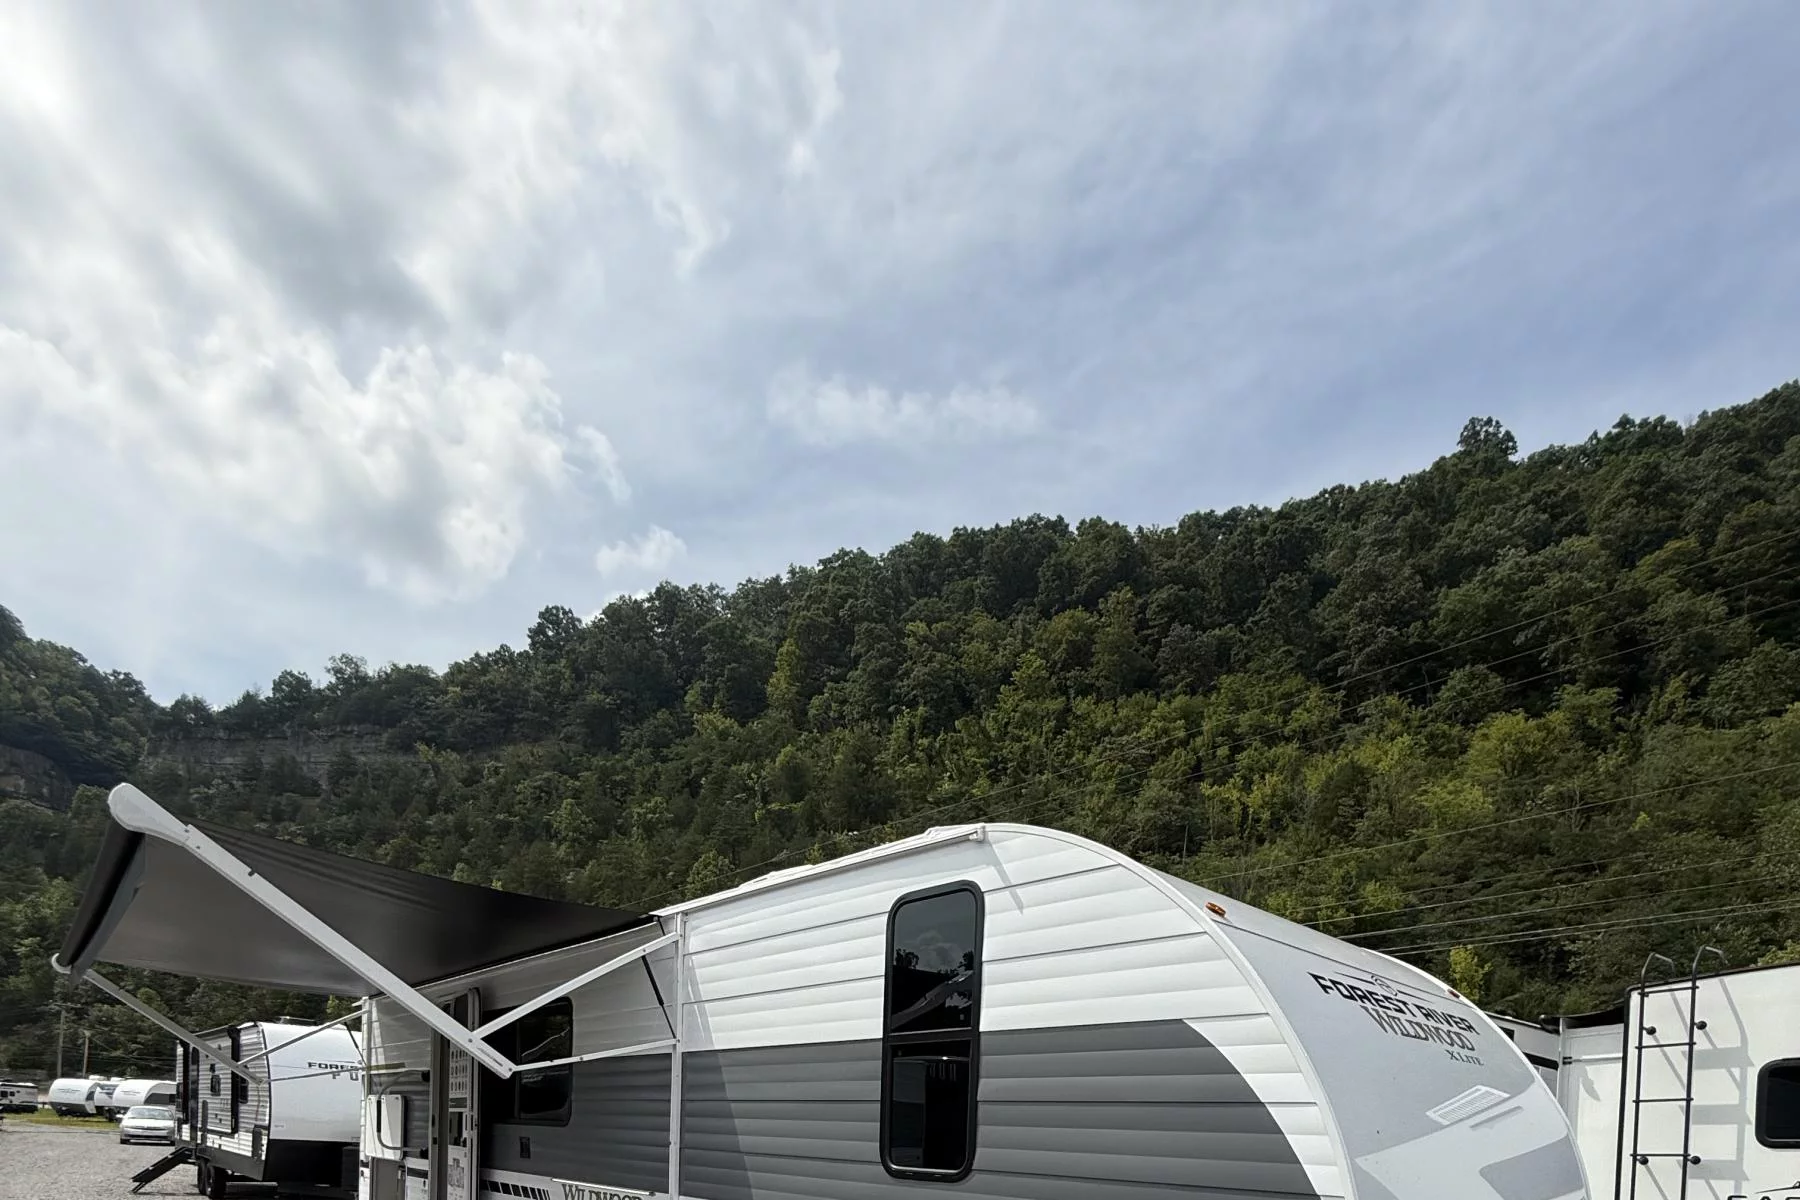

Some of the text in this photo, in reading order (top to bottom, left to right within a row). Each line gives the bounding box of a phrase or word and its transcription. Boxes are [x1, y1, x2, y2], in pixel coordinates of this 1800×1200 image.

[1307, 971, 1417, 1017] FOREST
[1410, 1003, 1481, 1035] RIVER
[1360, 1004, 1476, 1051] WILDWOOD
